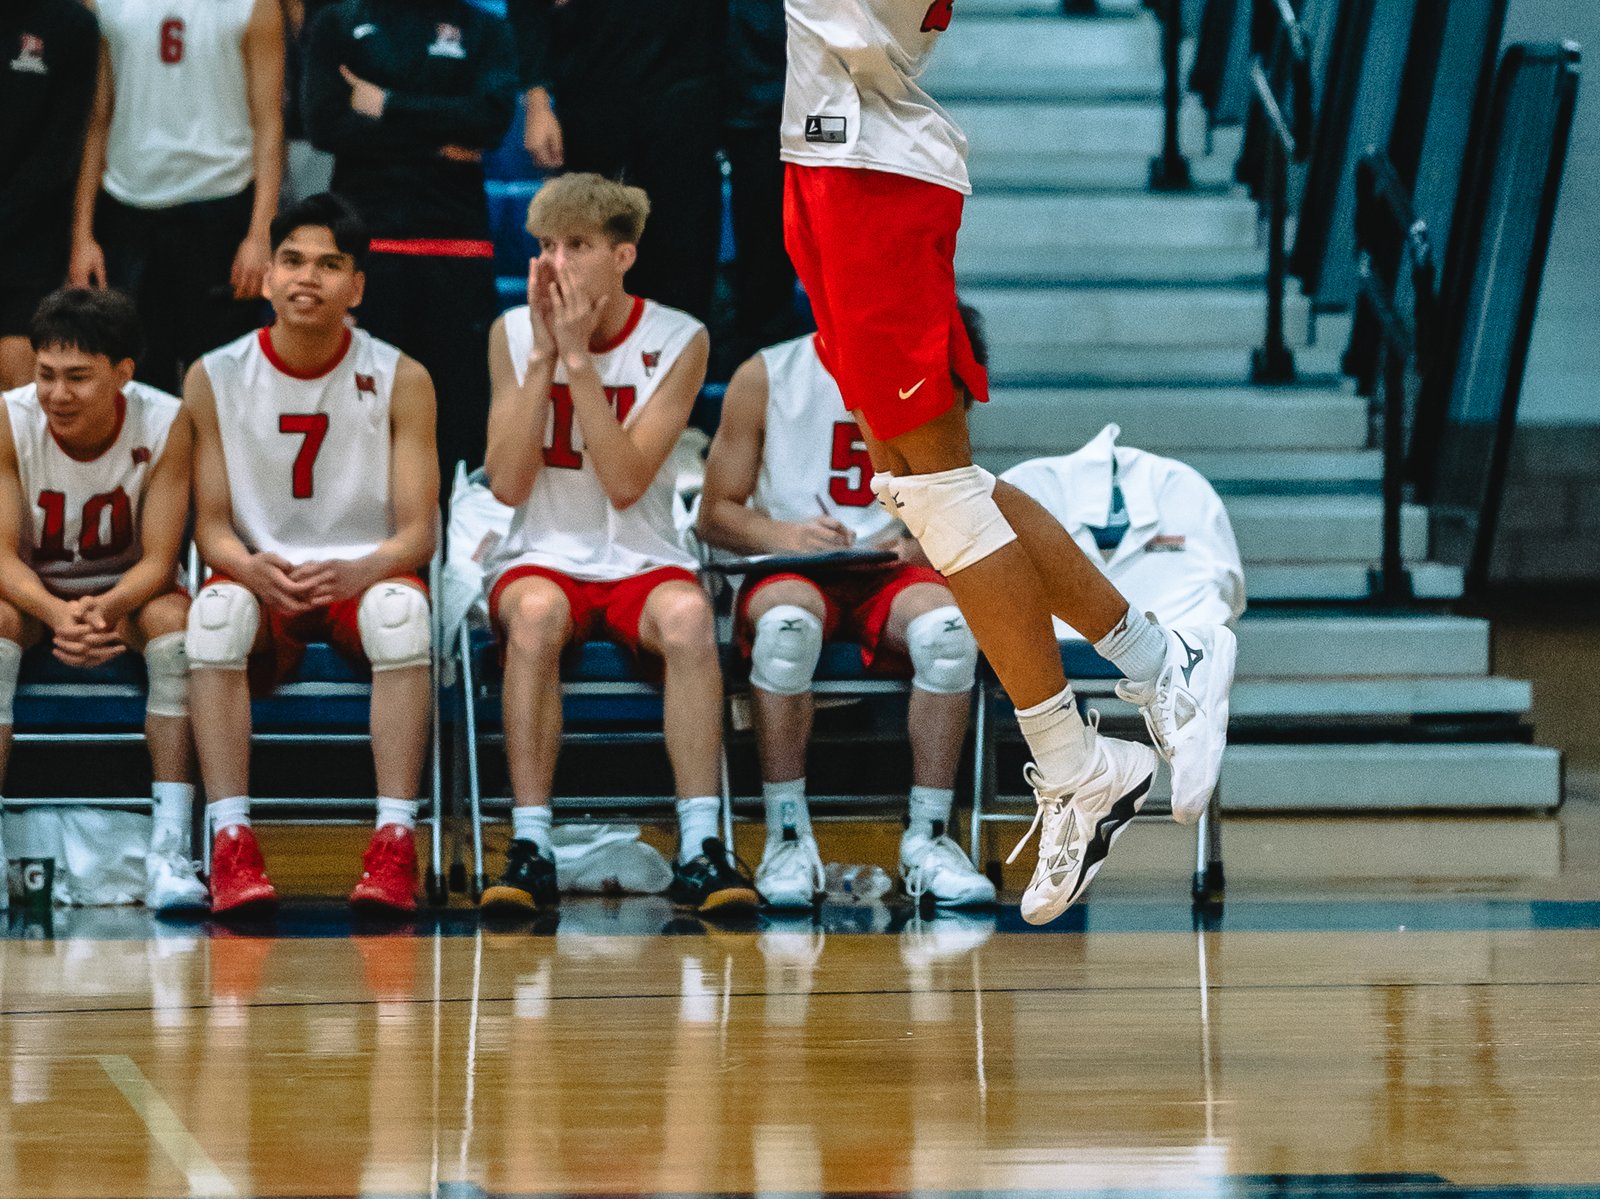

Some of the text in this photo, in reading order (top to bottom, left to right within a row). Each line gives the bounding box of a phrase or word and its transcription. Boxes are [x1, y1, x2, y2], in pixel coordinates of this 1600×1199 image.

[159, 18, 186, 65] 6
[279, 413, 329, 499] 7
[541, 383, 636, 470] 1
[830, 421, 877, 507] 5
[31, 485, 133, 562] 10
[24, 863, 45, 891] G
